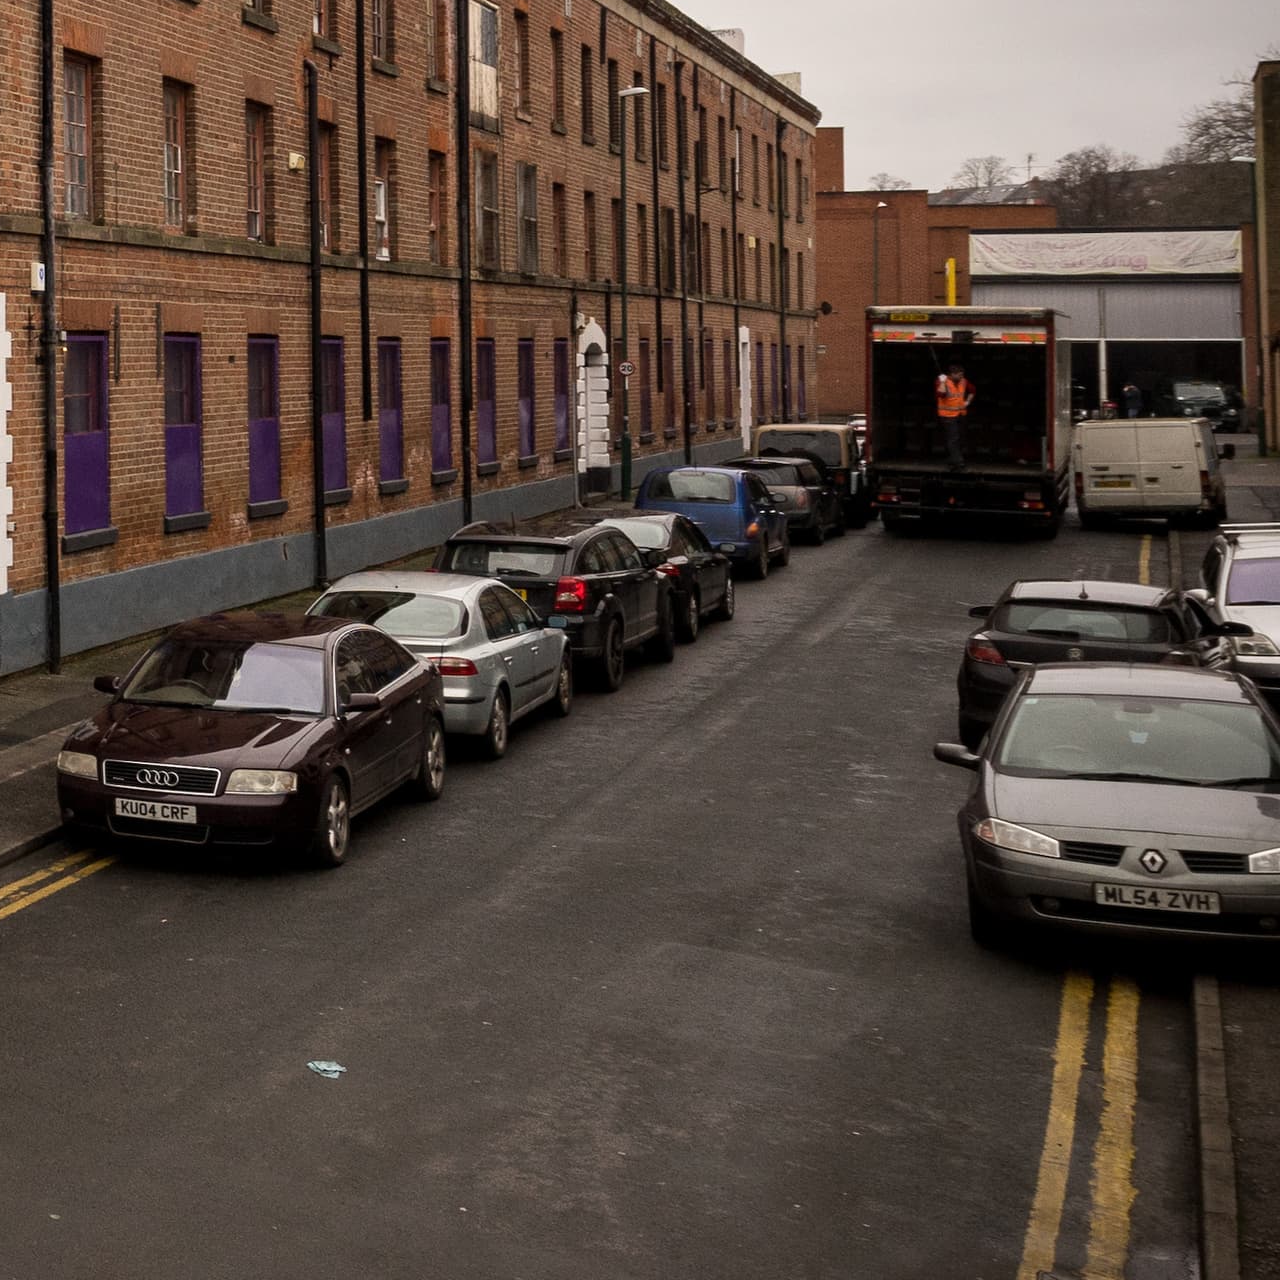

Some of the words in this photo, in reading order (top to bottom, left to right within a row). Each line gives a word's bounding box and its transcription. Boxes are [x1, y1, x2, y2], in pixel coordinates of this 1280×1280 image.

[121, 800, 157, 817] KU04
[161, 805, 190, 820] CRF
[1103, 886, 1160, 907] ML54
[1167, 892, 1210, 910] ZVH
